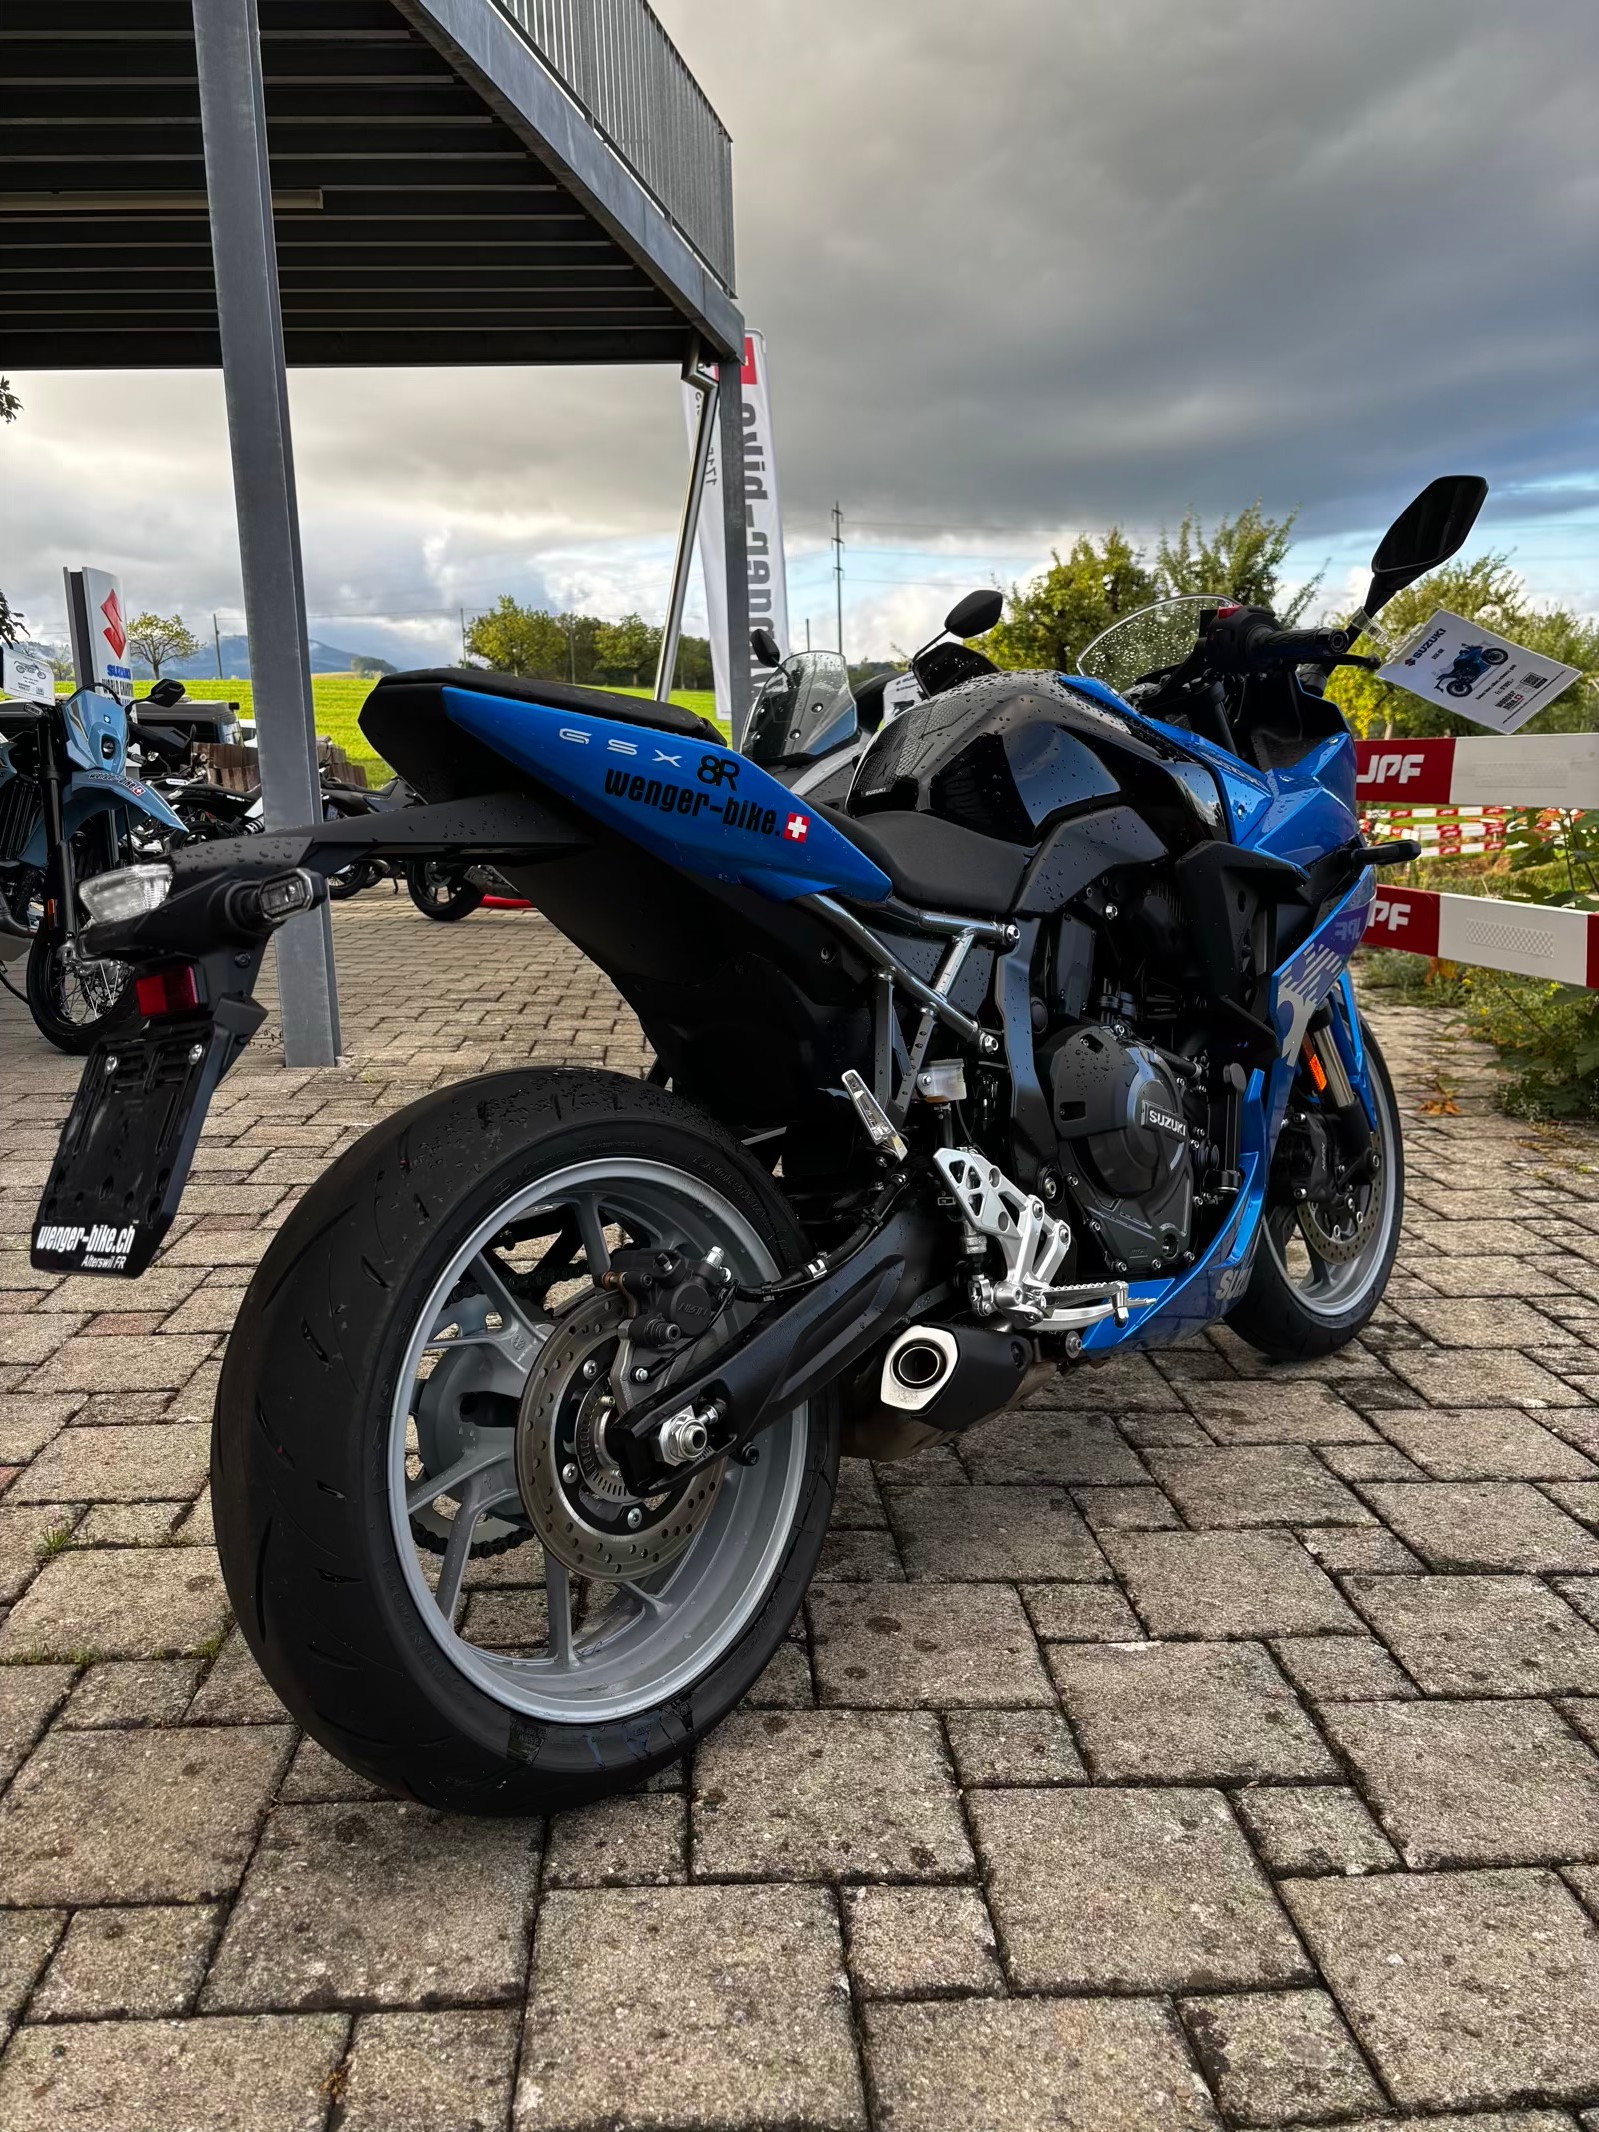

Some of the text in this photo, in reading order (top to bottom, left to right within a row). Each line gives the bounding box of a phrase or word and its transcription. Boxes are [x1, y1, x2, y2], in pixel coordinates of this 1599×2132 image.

[1411, 627, 1447, 658] SUZUKI
[697, 755, 739, 791] 8R
[1356, 754, 1425, 784] JPF
[1149, 1109, 1187, 1136] SUZUKI
[36, 1224, 136, 1254] wenger-bike.ch
[81, 1254, 127, 1269] Alterswil FR
